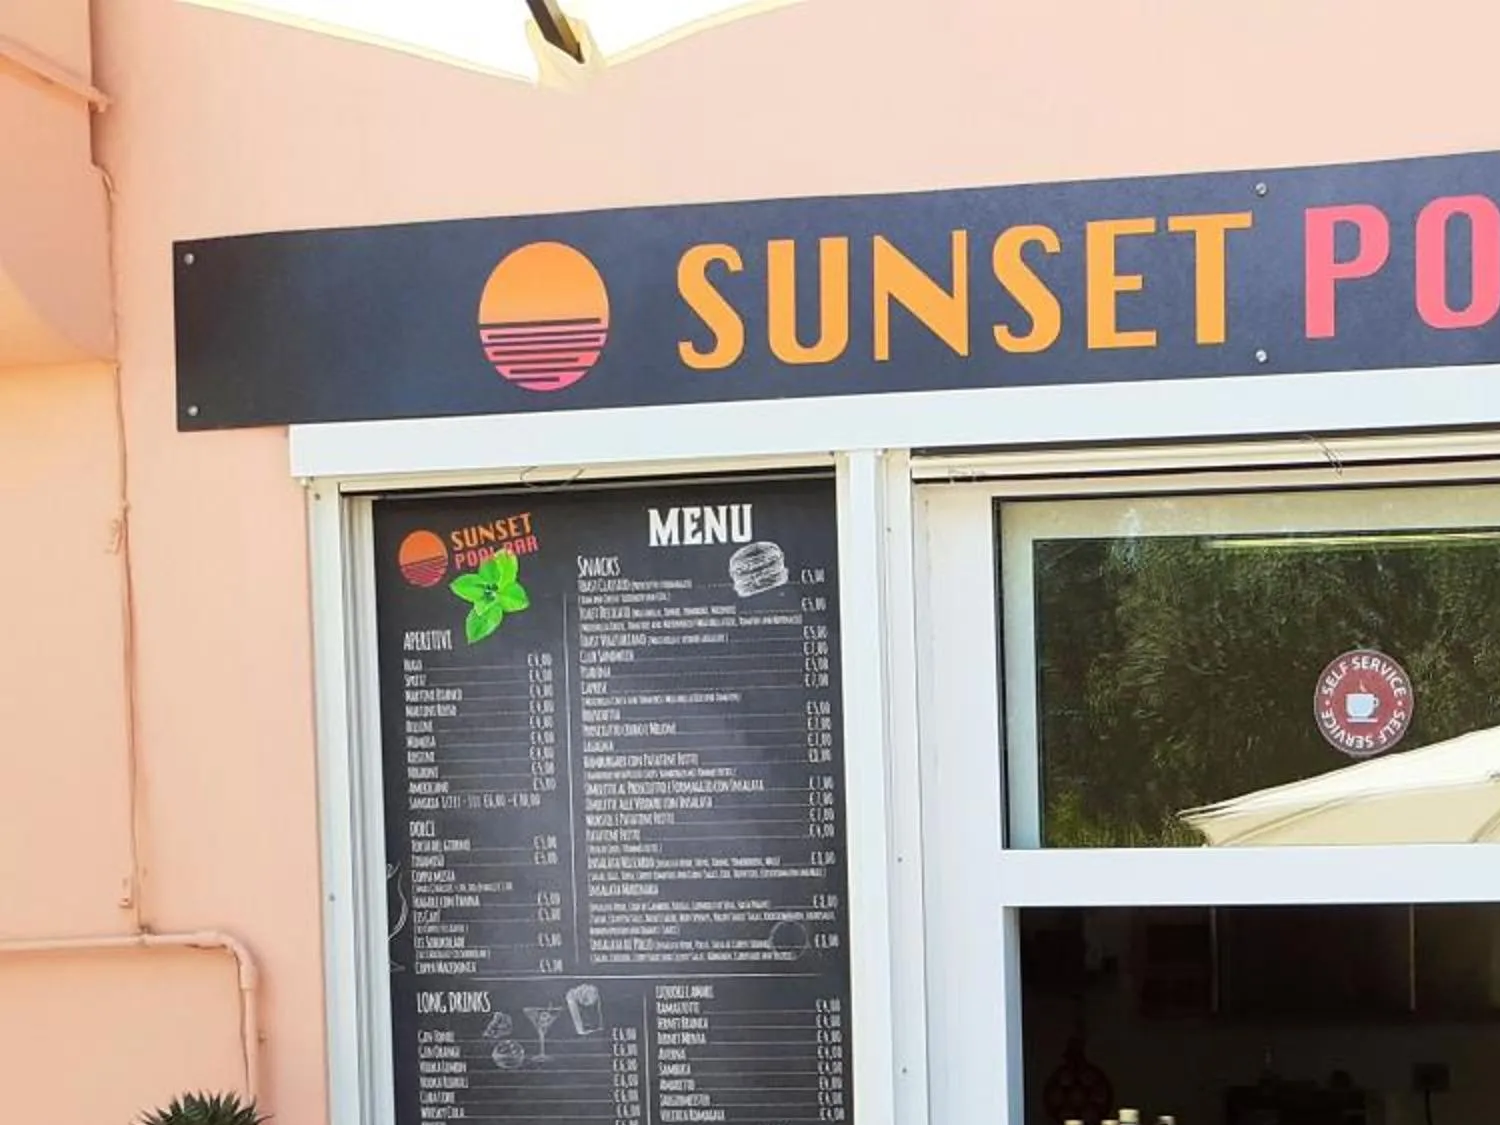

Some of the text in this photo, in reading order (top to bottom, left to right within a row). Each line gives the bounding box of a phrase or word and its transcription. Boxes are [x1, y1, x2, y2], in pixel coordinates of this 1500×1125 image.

[677, 211, 1253, 370] SUNSET
[451, 511, 533, 551] SUNSET
[648, 503, 753, 547] MENU
[577, 555, 620, 578] SNACKS
[1321, 656, 1407, 698] SELF SERVICE
[1321, 707, 1406, 749] SELF SERVICE
[417, 991, 491, 1013] LONG DRINKS
